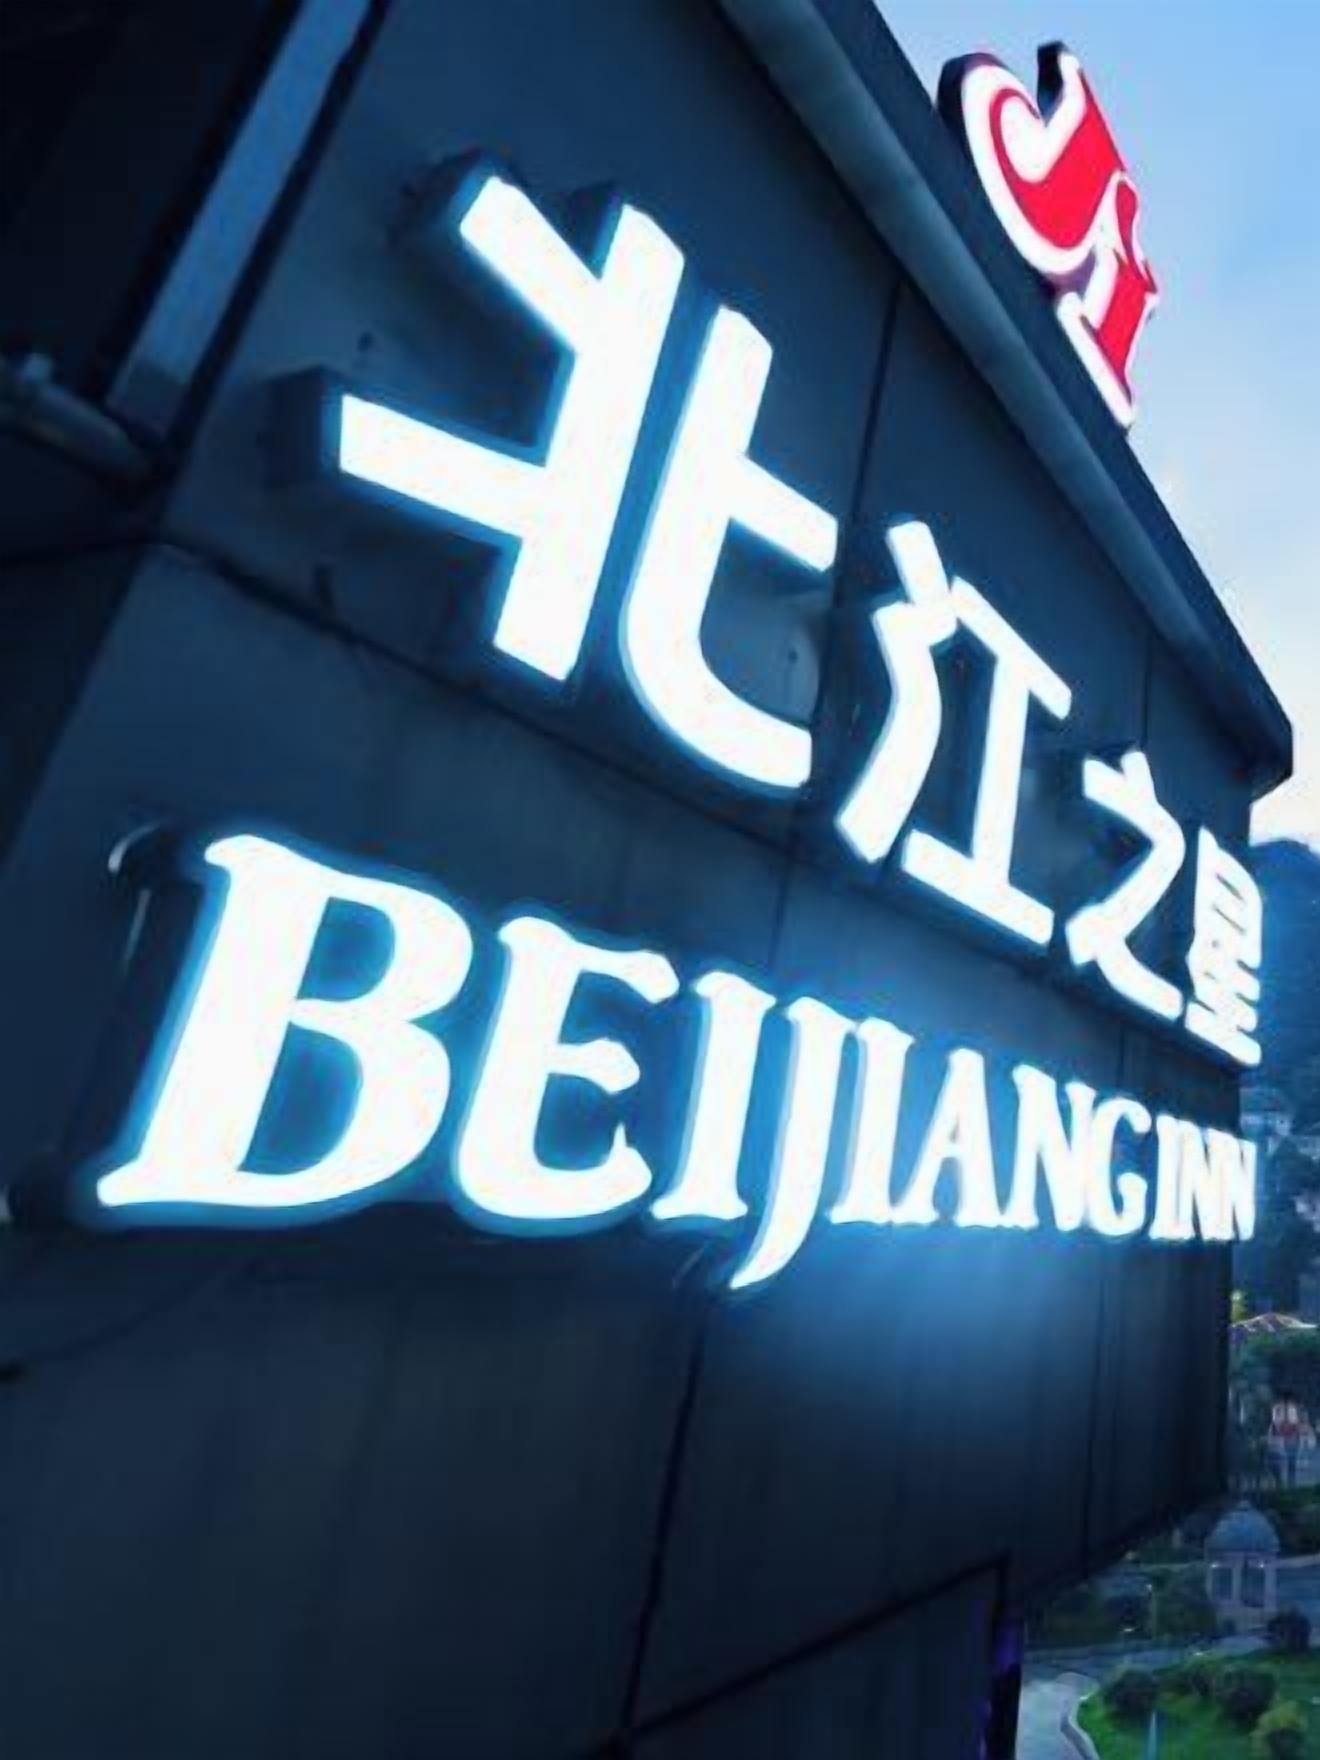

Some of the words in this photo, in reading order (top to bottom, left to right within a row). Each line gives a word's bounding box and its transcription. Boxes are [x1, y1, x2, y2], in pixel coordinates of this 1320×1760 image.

[338, 175, 1262, 1066] 北江之星
[97, 834, 1152, 1289] BEIJIANG
[1149, 1114, 1257, 1241] INN
